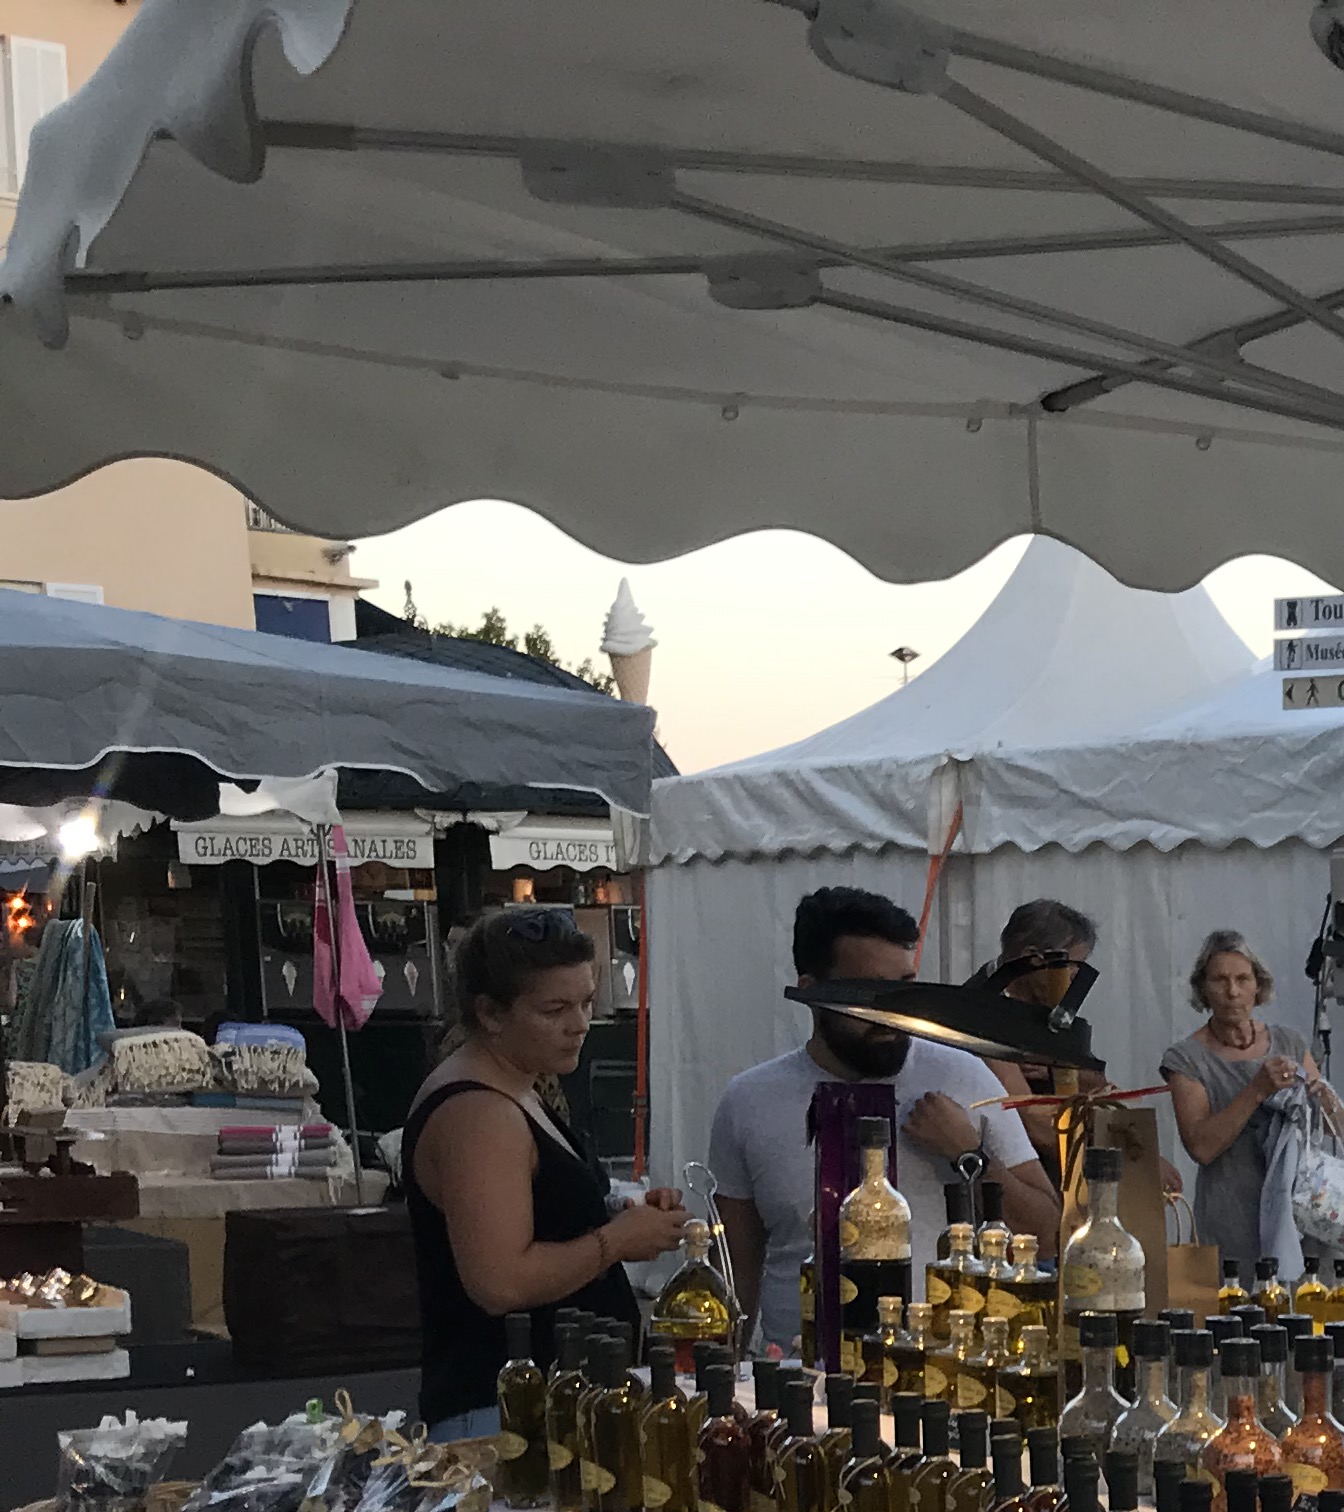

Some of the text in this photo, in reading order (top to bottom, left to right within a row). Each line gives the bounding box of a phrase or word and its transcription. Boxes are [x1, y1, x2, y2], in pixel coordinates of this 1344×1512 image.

[194, 836, 417, 860] GLACES ARTSNALES
[529, 841, 599, 862] GLACES
